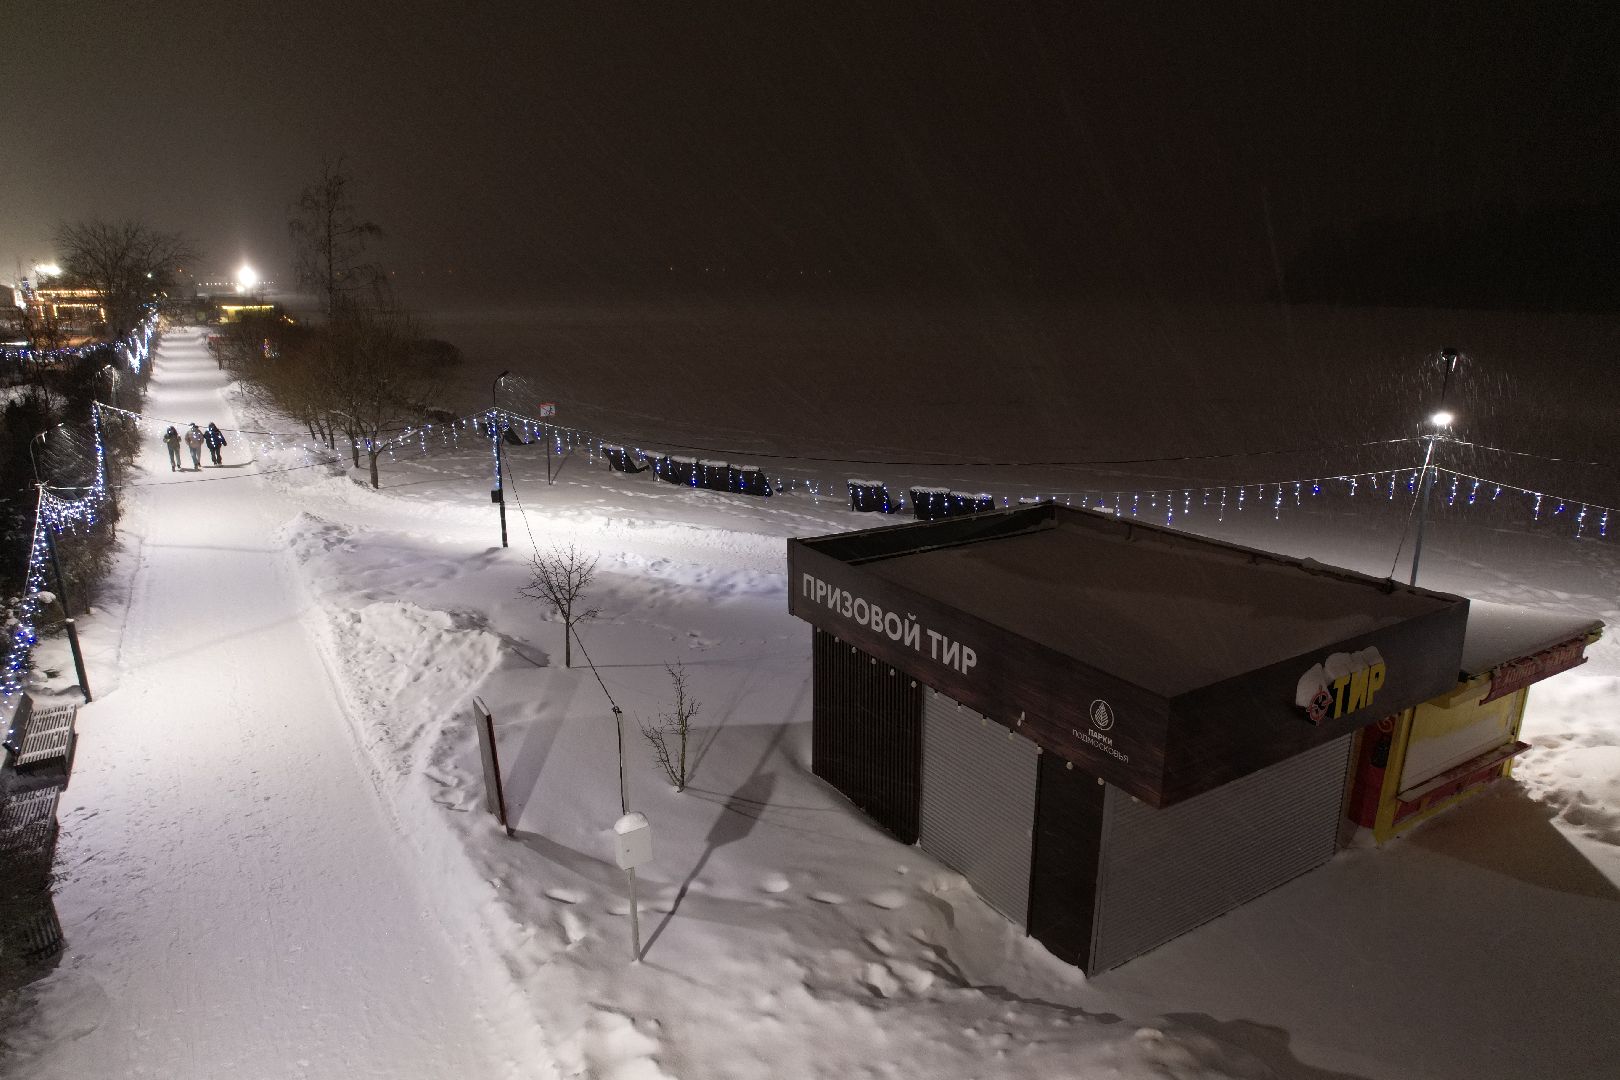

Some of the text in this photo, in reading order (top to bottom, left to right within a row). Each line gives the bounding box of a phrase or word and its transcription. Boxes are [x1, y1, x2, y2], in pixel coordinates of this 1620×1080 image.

[803, 573, 977, 675] ПРИЗОВОЙ ТИР
[1334, 663, 1385, 719] ТИР
[1072, 729, 1129, 763] ПОДМОСКОВЬЯ
[1088, 729, 1113, 747] ПАРКИ
